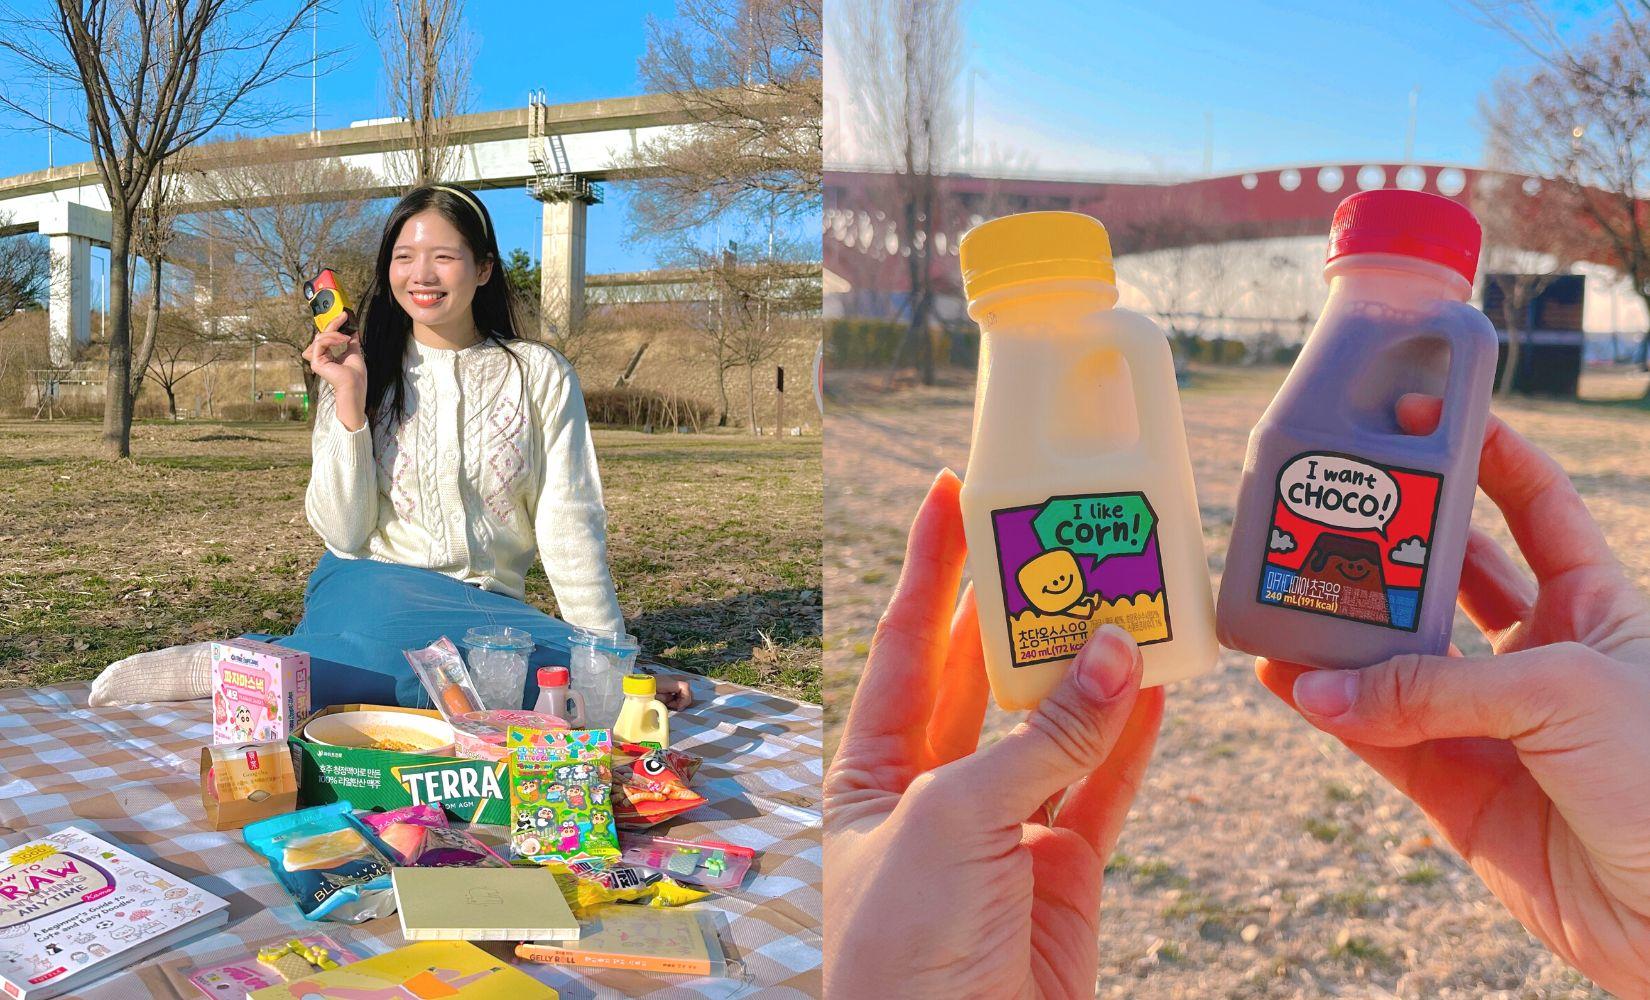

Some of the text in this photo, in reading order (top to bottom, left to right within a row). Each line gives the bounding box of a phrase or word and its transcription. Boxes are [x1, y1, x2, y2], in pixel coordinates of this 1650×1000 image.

[1306, 461, 1377, 489] I want
[1073, 503, 1124, 520] I like
[1288, 482, 1391, 521] CHOCO!
[1265, 591, 1281, 601] 240
[1315, 599, 1338, 613] kcal)
[1021, 650, 1036, 660] 240
[318, 775, 338, 784] 100%
[401, 766, 504, 806] TERRA
[20, 864, 41, 874] TO
[19, 884, 88, 916] ANYTIME
[37, 899, 136, 942] Cute and Easy Doodles
[41, 912, 87, 934] Beginner's
[89, 902, 112, 912] Guide
[530, 953, 554, 962] GELLY
